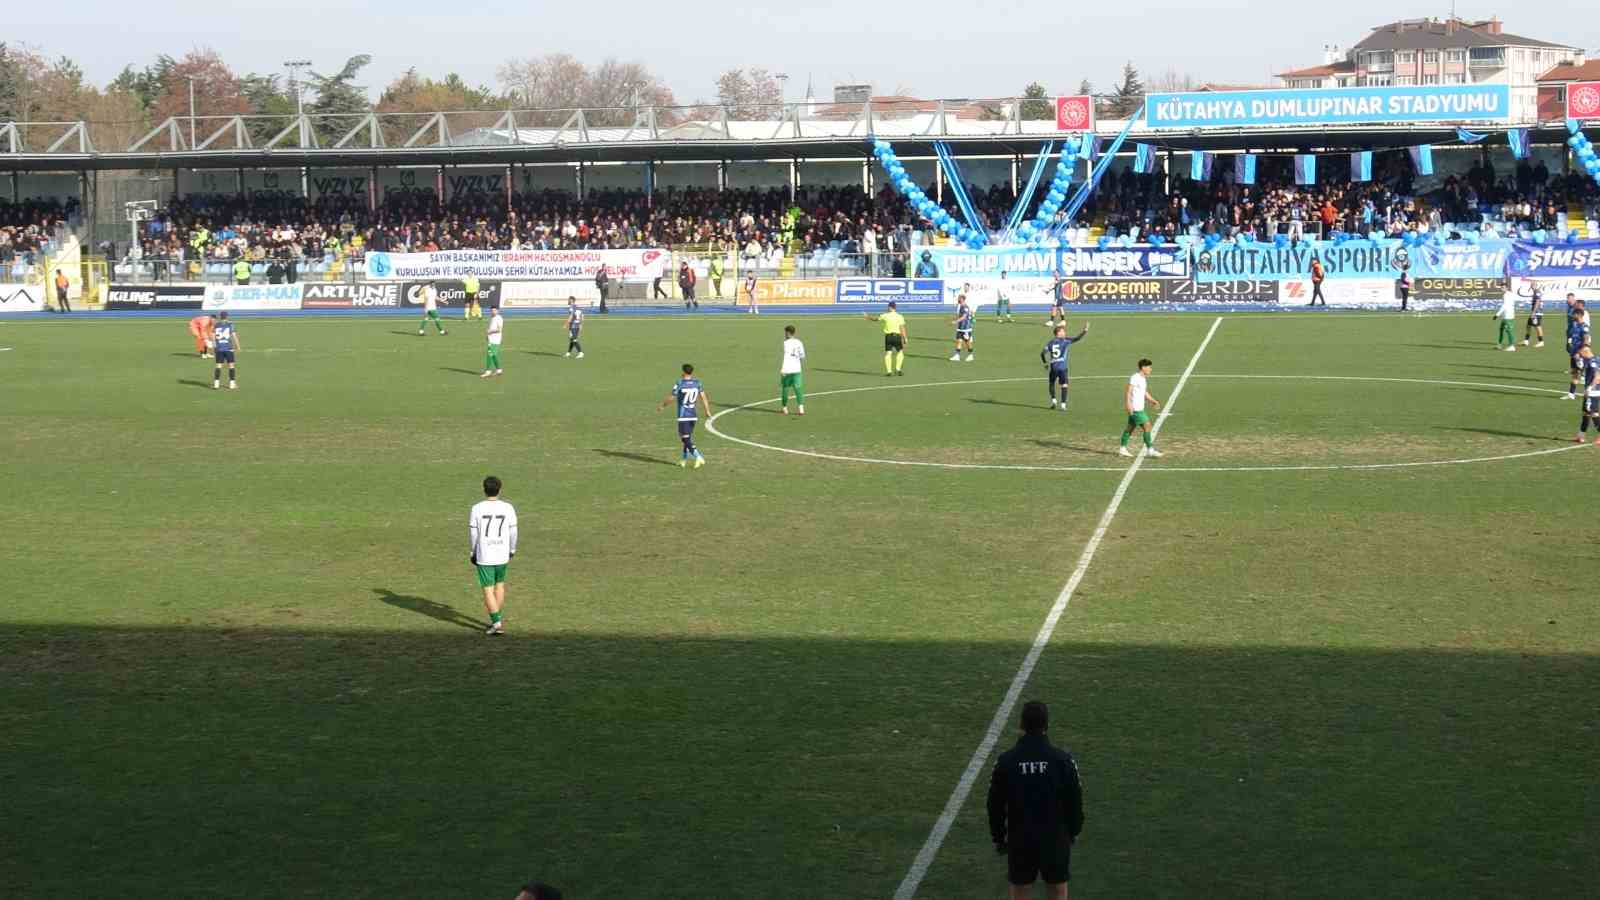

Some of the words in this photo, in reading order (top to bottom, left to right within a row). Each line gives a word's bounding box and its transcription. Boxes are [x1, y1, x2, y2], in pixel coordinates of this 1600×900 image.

[1157, 97, 1245, 121] KÜTAHYA
[1388, 93, 1498, 114] STADYUMU
[442, 266, 453, 276] VE
[306, 284, 397, 298] ARTLINE
[772, 283, 833, 298] Plantin
[840, 281, 939, 294] ACL
[1172, 280, 1272, 295] ZERDE
[352, 298, 397, 306] HOME
[1052, 344, 1061, 358] 5
[681, 388, 699, 404] 70
[482, 514, 505, 537] 77
[1019, 761, 1048, 775] TFF
